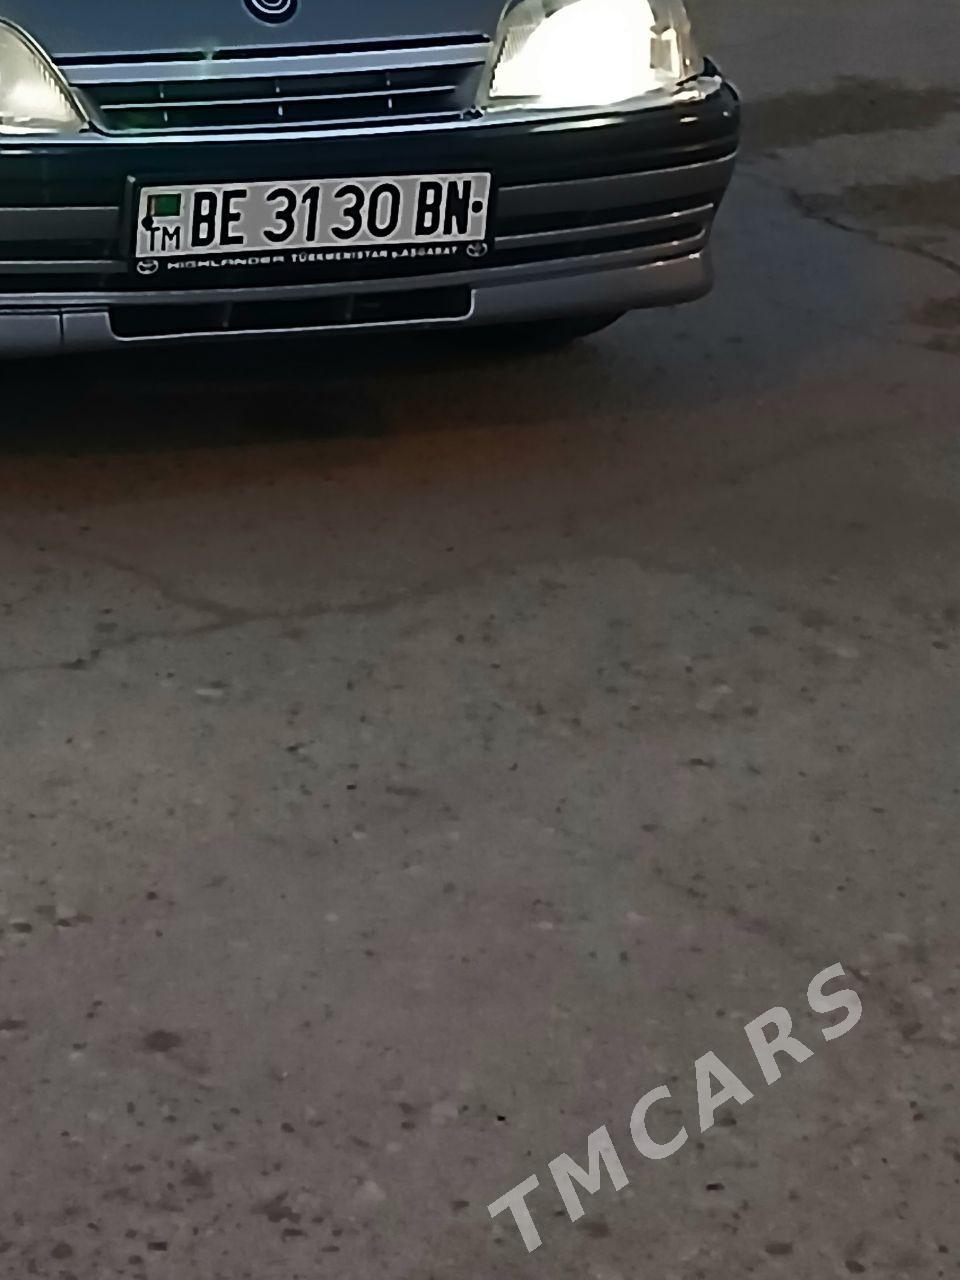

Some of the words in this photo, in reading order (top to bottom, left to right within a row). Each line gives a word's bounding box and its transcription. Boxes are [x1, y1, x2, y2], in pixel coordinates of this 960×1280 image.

[191, 189, 247, 247] BE
[415, 180, 472, 235] BN
[146, 226, 181, 251] TM
